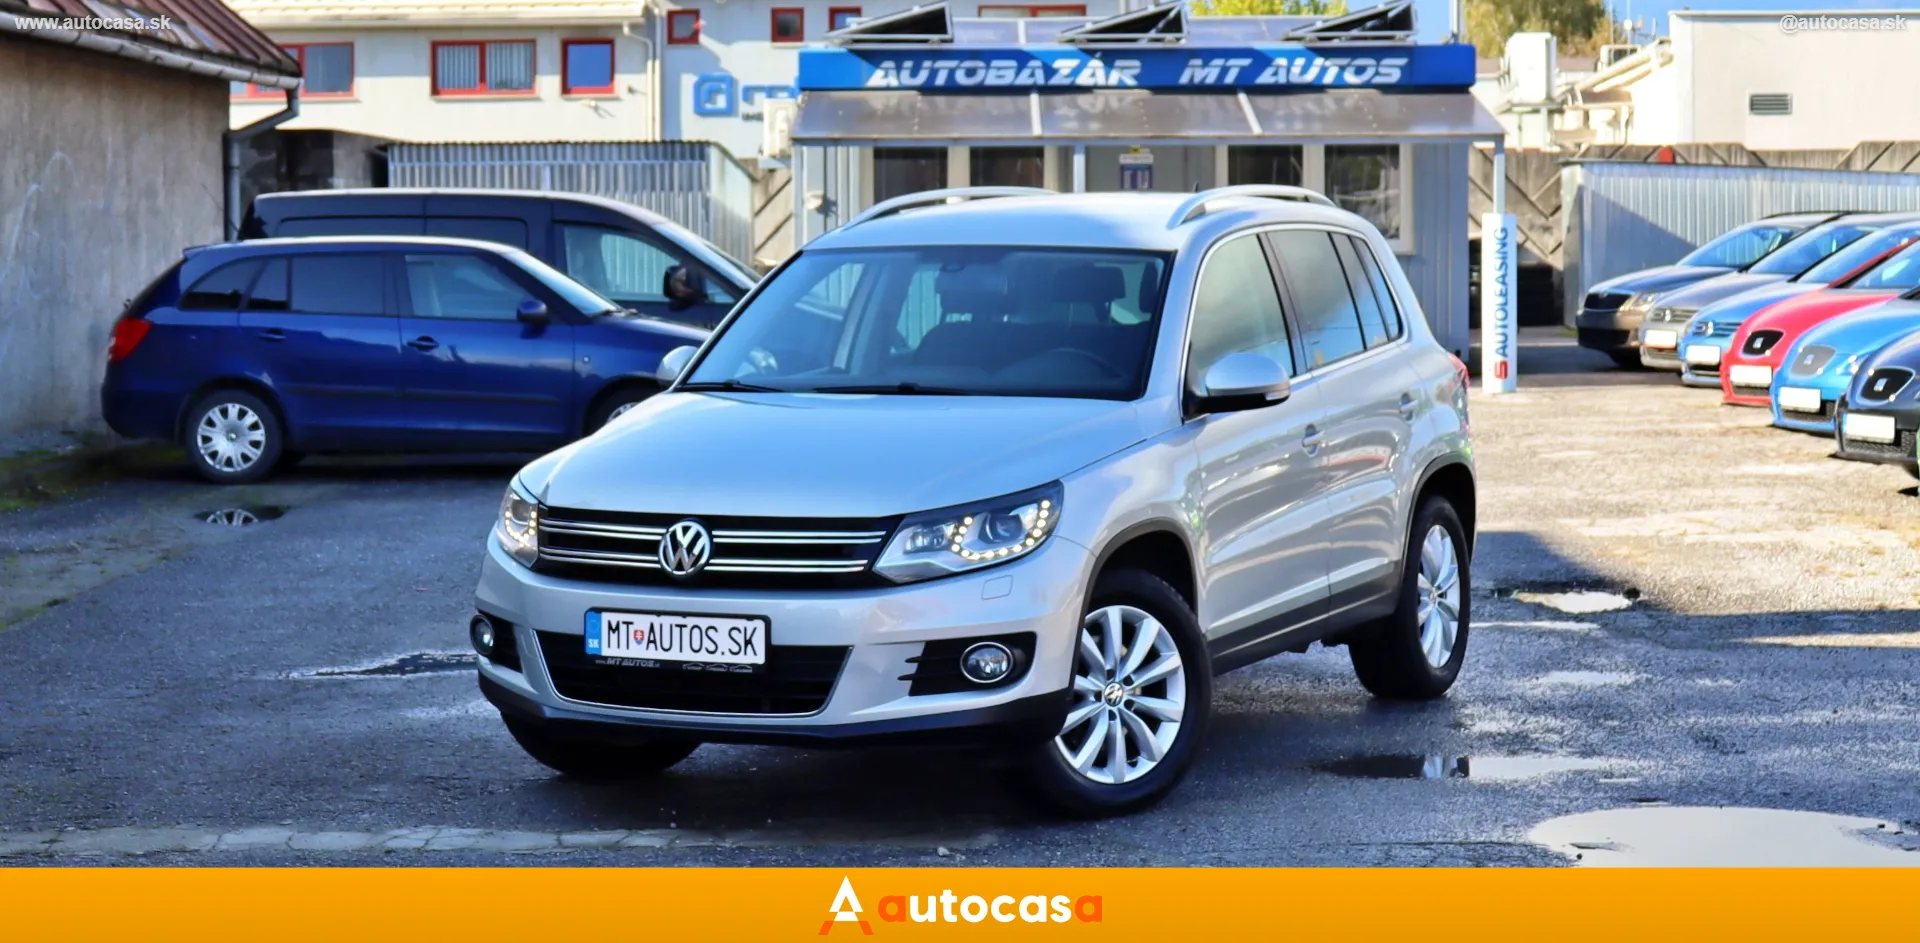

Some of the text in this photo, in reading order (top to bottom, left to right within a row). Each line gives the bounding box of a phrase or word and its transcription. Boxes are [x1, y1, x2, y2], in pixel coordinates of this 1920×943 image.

[865, 52, 1409, 88] AUTOBAZÁR MT AUTOS
[1494, 227, 1508, 358] AUTOLEASING
[588, 638, 600, 649] SK
